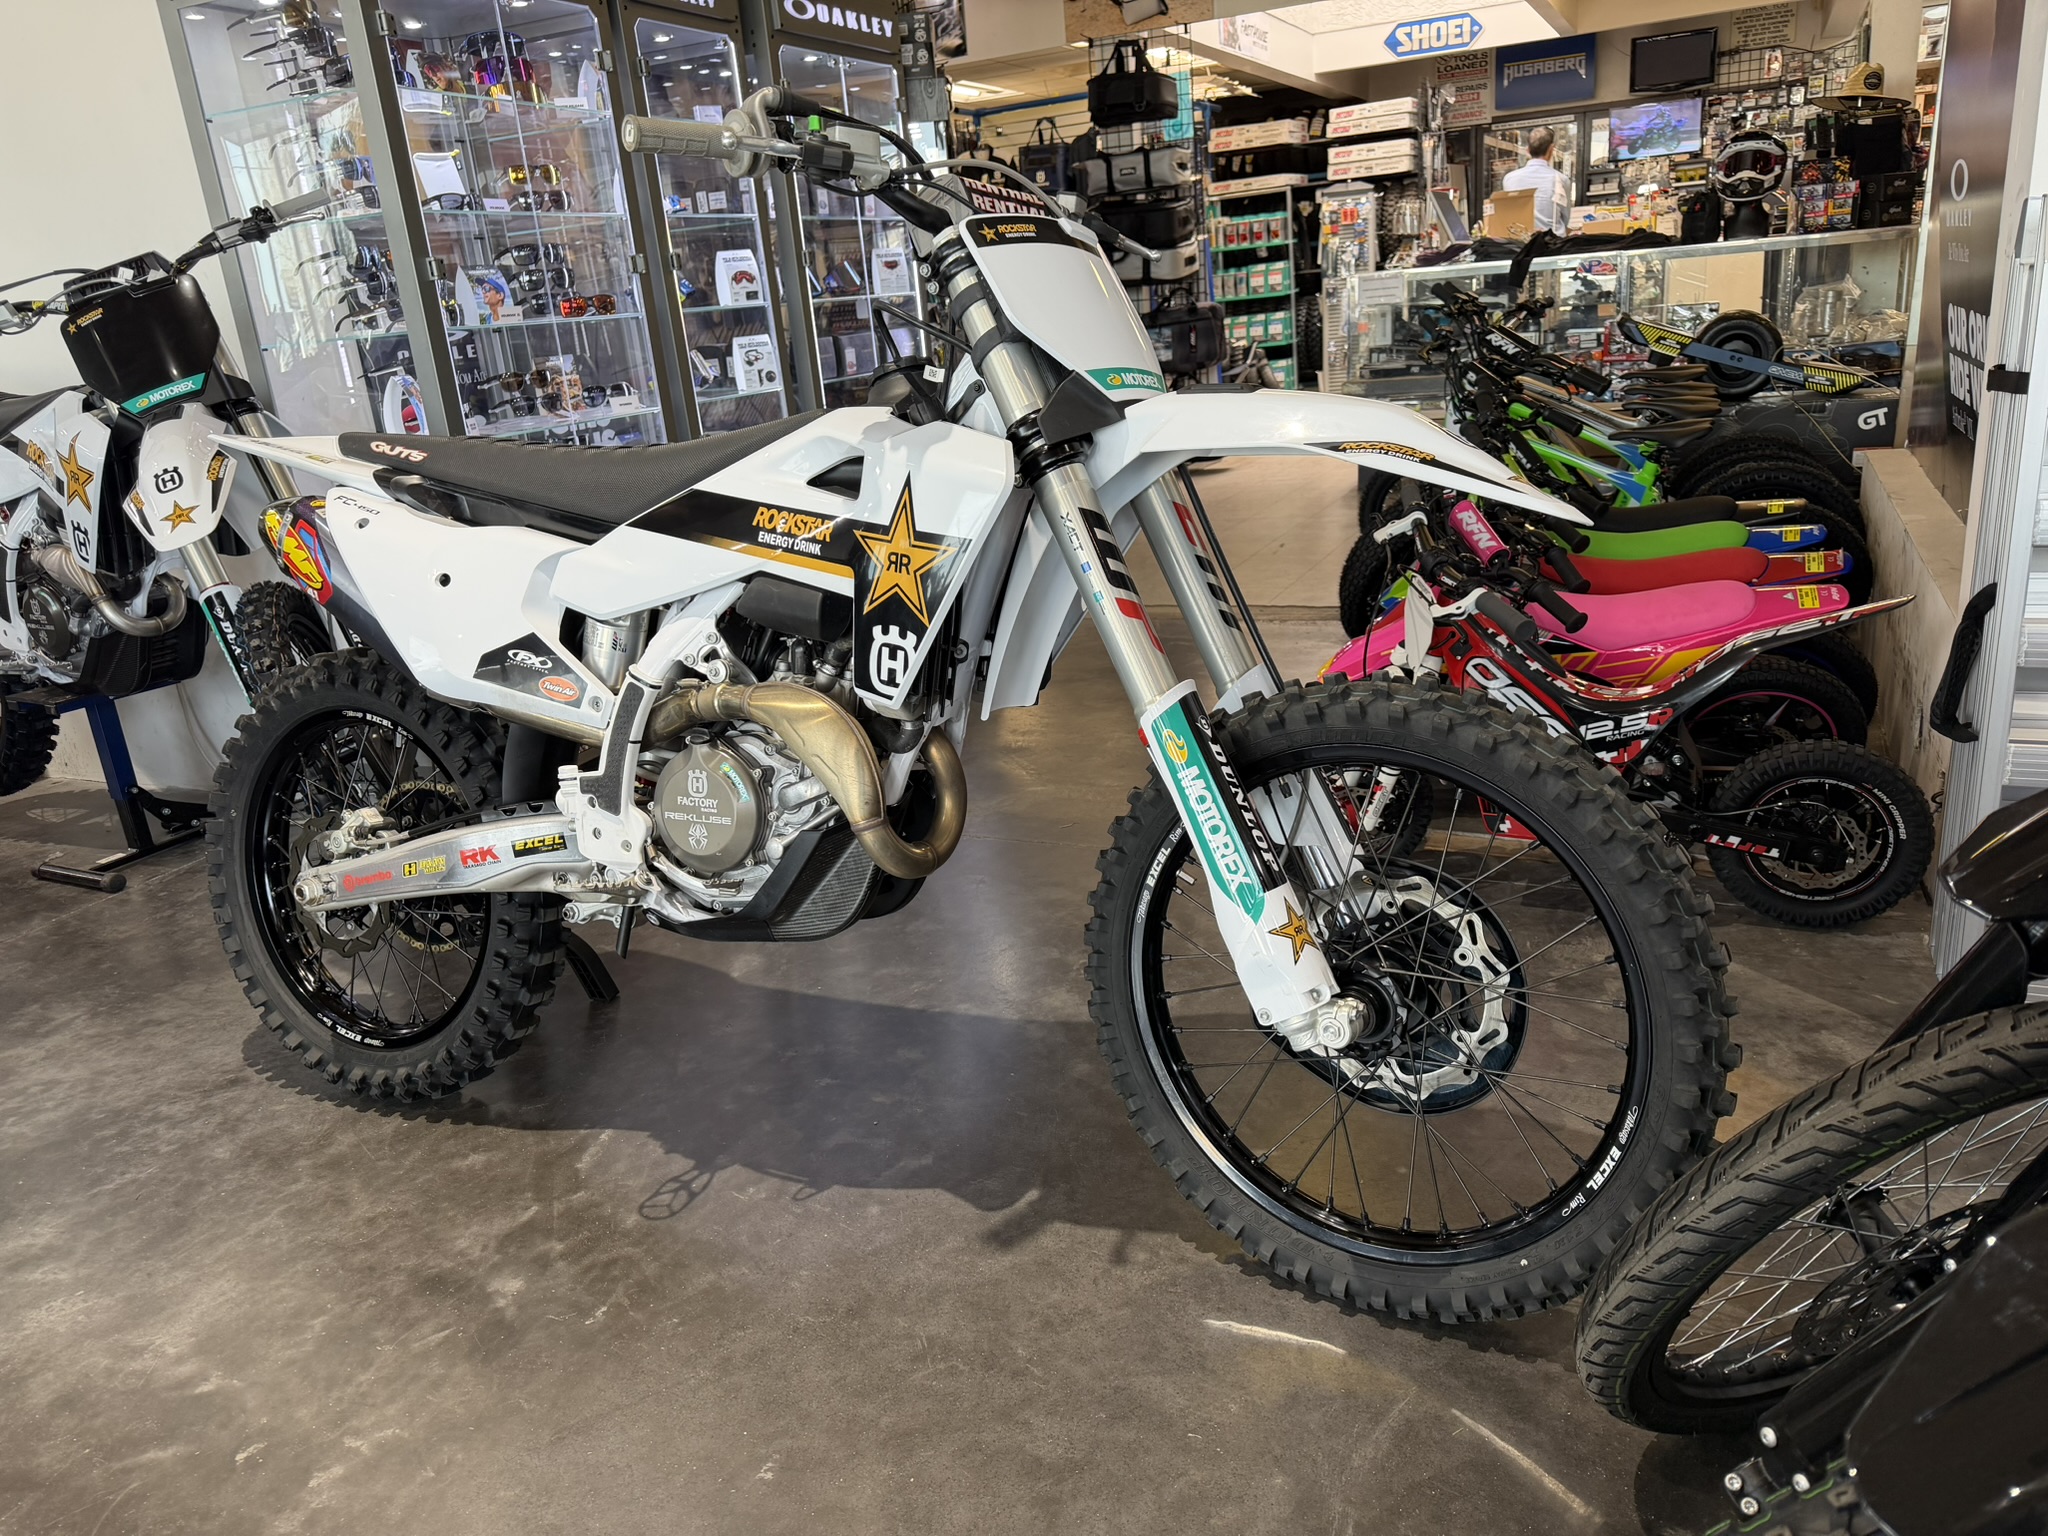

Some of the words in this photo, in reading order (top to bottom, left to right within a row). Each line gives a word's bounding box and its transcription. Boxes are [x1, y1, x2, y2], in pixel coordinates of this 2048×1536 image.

[814, 2, 894, 39] OAKLEY
[1394, 16, 1472, 53] SHOEI
[1436, 60, 1488, 74] LOANED
[1451, 51, 1489, 63] TOOLS
[1503, 56, 1587, 89] HUSABERG
[1453, 93, 1478, 102] ASH
[1455, 82, 1488, 93] REPAIRS
[972, 193, 1048, 218] RENTHAL
[996, 223, 1037, 235] ROCKSTAR
[77, 307, 104, 327] ROCKSTAR
[1485, 332, 1522, 355] RFN
[1947, 302, 1968, 354] OUR
[1968, 309, 1991, 363] ORI
[1120, 371, 1162, 390] MOTOREX
[1948, 352, 1971, 407] RIDE
[149, 380, 196, 403] MOTOREX
[1857, 406, 1889, 431] GT
[370, 441, 431, 462] GUTS
[1339, 440, 1436, 461] ROCKSTAR
[1345, 448, 1387, 457] ENERGY
[1388, 450, 1422, 463] DRINK
[334, 495, 359, 507] FC
[753, 506, 834, 543] ROCKSTAR
[1060, 511, 1085, 552] XACT
[1455, 508, 1498, 551] RFN
[758, 531, 795, 548] ENERGY
[794, 538, 822, 556] DRINK
[542, 680, 563, 695] Twin
[561, 686, 577, 697] Air
[365, 712, 394, 729] EXCEL
[1605, 728, 1646, 742] RACING
[728, 768, 749, 801] MOTOREX
[677, 796, 719, 809] FACTORY
[1208, 740, 1281, 873] DUNLOP
[1871, 787, 1889, 804] MINI
[1888, 803, 1908, 841] GRIPPER
[664, 811, 732, 825] REKLUSE
[1176, 765, 1252, 893] MOTOREX
[514, 834, 564, 850] EXCEL
[459, 843, 501, 867] RK
[487, 859, 502, 868] CHAIN
[355, 870, 392, 887] brembo
[1147, 846, 1171, 888] EXCEL
[336, 1024, 362, 1043] EXCEL
[1585, 1145, 1623, 1191] EXCEL
[1561, 1192, 1587, 1217] Rim
